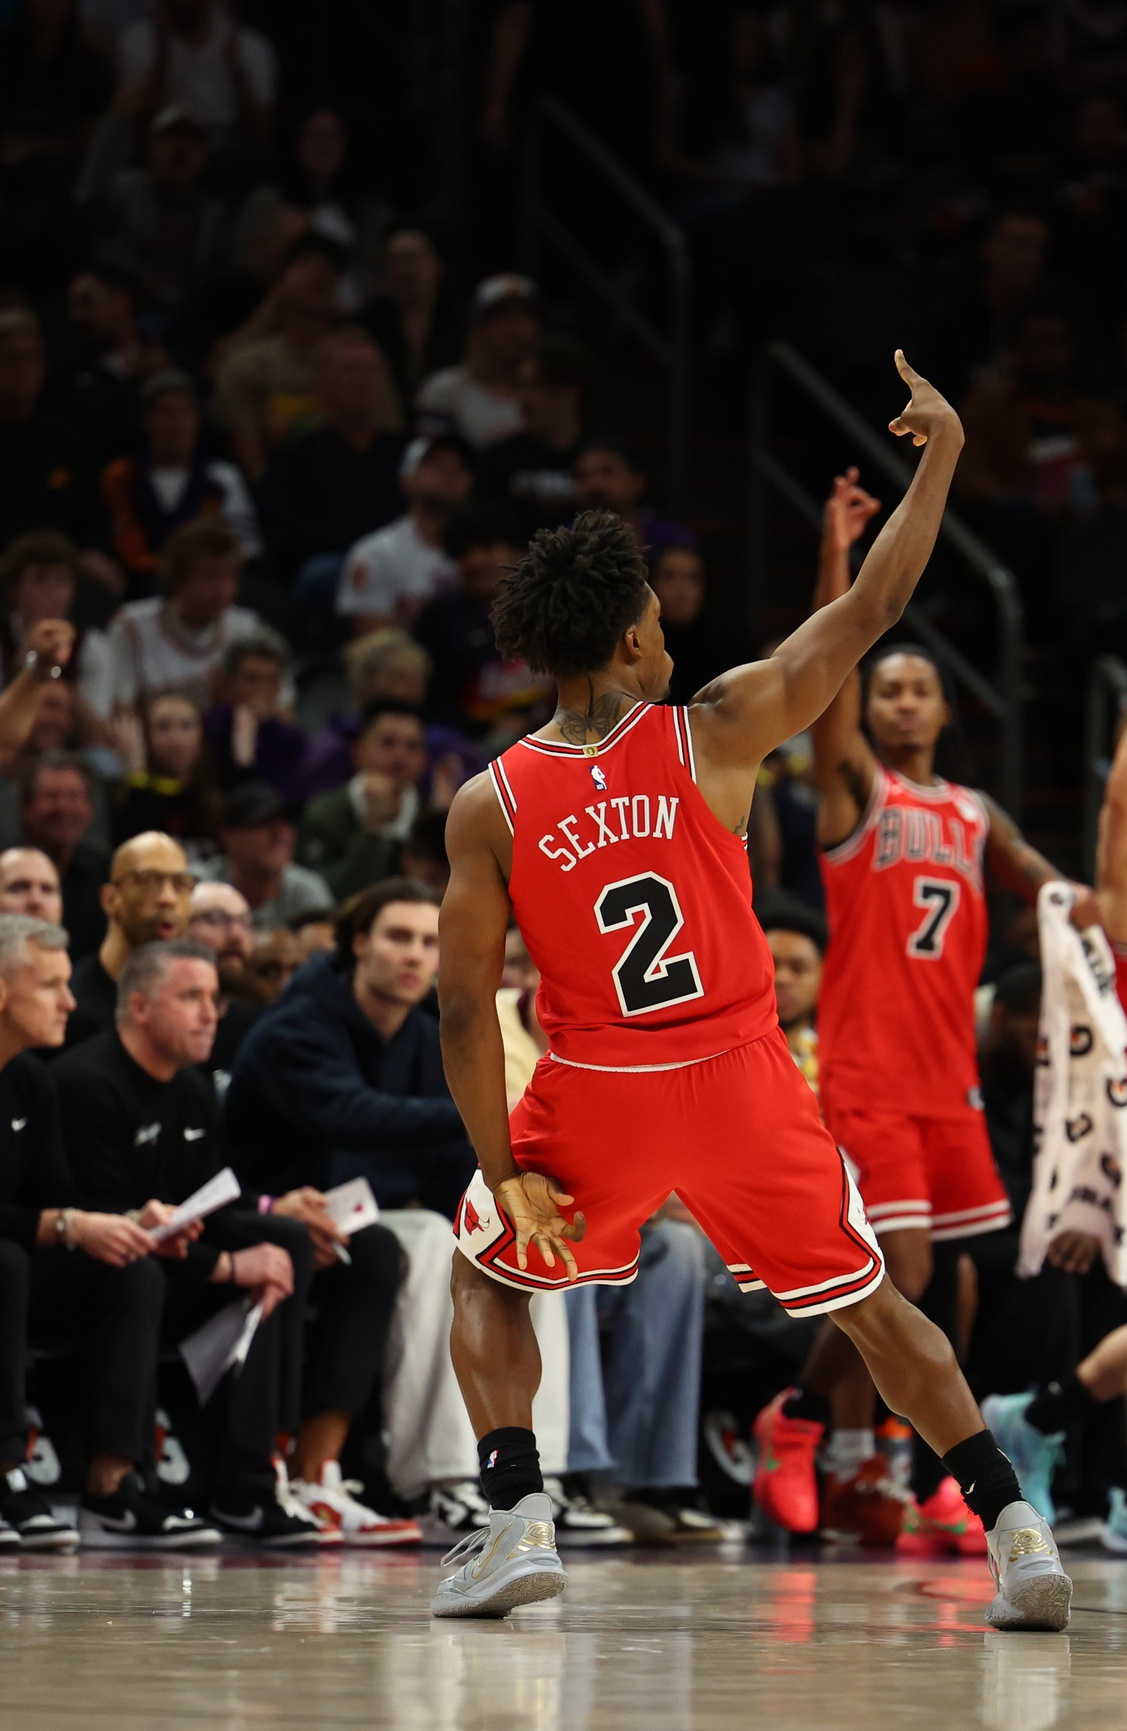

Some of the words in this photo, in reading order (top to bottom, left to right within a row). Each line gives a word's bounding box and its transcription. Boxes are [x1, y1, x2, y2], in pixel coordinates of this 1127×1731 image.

[538, 794, 679, 872] SEXTON
[593, 870, 704, 1017] 2
[906, 875, 960, 961] 7
